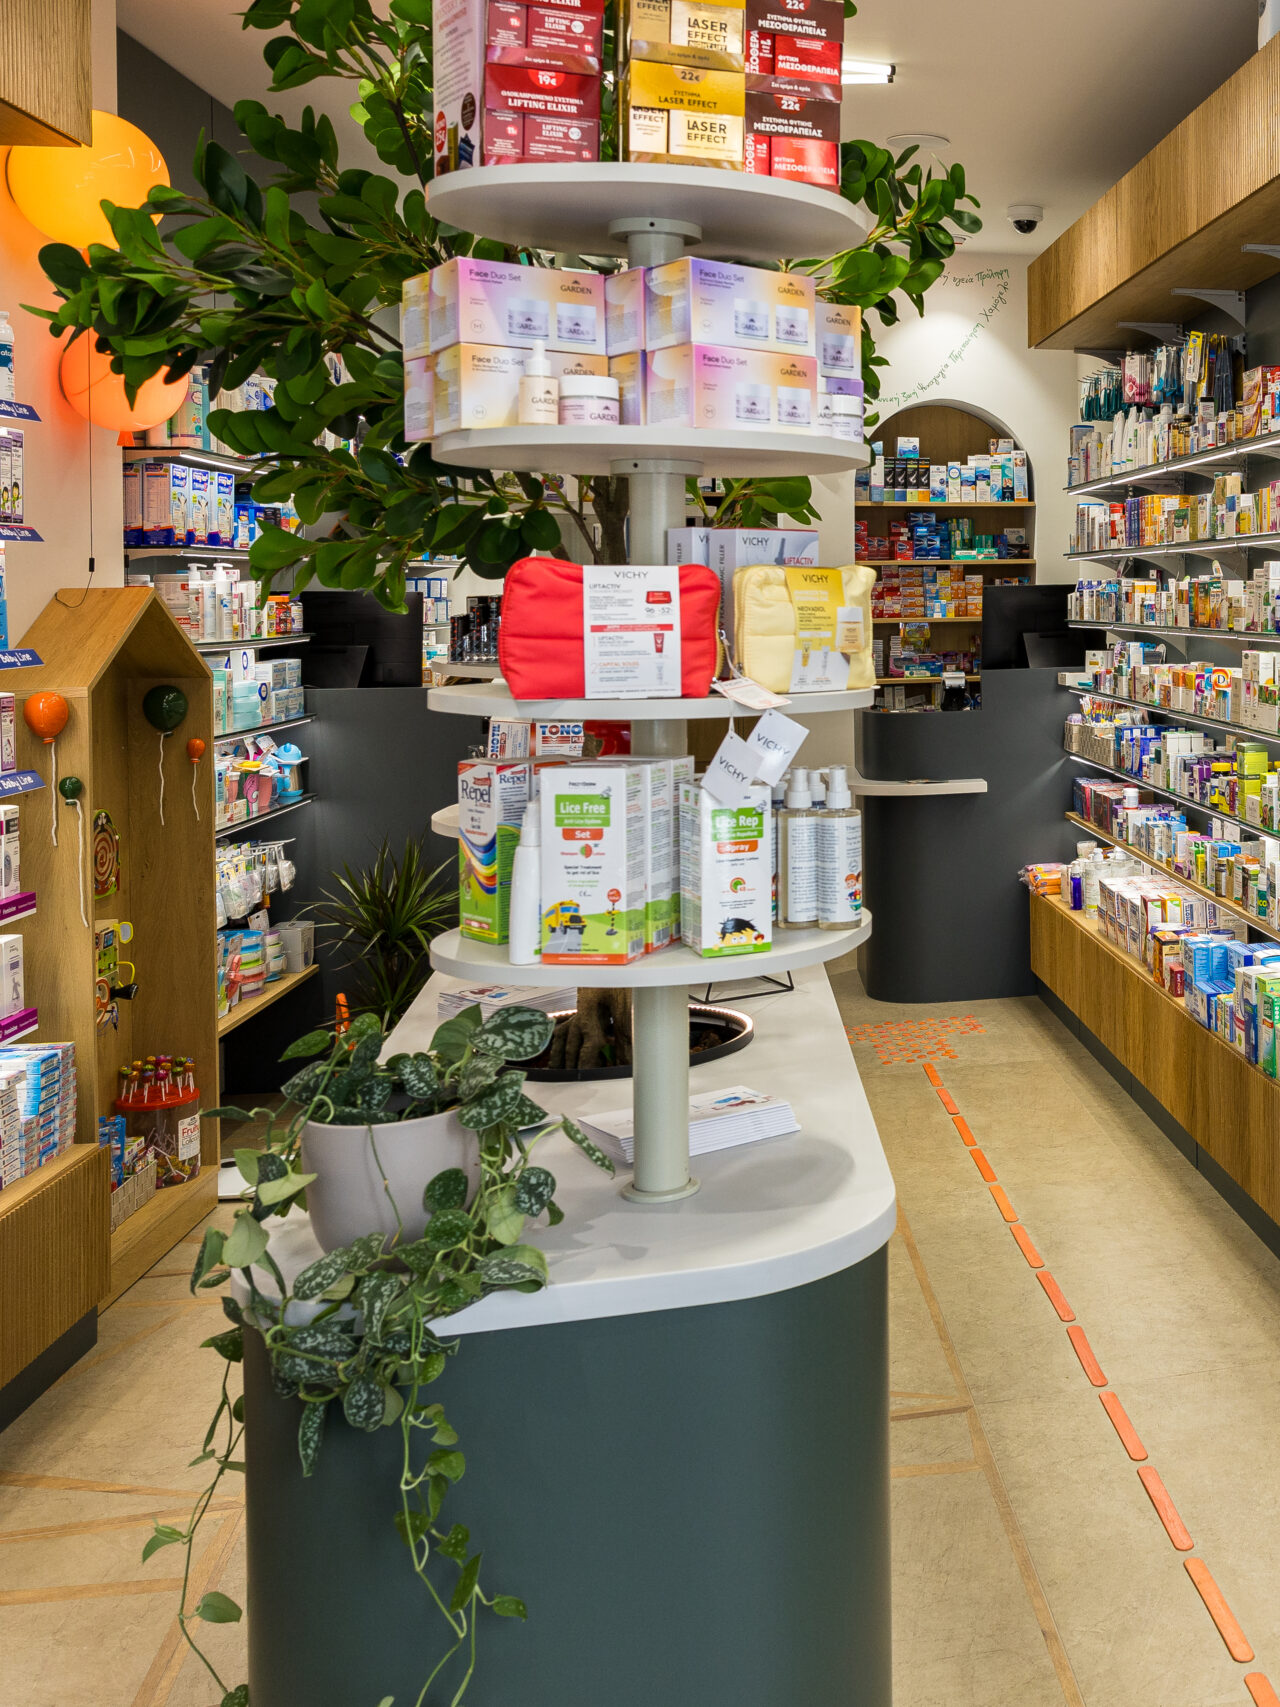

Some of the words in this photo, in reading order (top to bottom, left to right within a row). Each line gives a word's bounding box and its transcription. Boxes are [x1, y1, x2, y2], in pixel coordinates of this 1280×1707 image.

[688, 18, 728, 32] LASER
[758, 20, 827, 37] ΜΕΣΟΘΕΡΑΠΕΙΑΣ
[688, 30, 727, 42] EFFECT
[778, 62, 839, 76] ΜΕΣΟΘΕΡΑΠΕΙΑ
[538, 74, 557, 86] 19€
[681, 71, 700, 81] 22€
[508, 98, 545, 110] LIFTING
[547, 103, 578, 113] ELIXIR
[659, 96, 684, 105] LASER
[688, 99, 717, 109] EFFECT
[781, 100, 800, 111] 22€
[633, 113, 665, 123] EFFECT
[687, 120, 727, 134] LASER
[754, 122, 823, 137] ΜΕΣΟΘΕΡΑΠΕΙΑΣ
[687, 133, 727, 144] EFFECT
[469, 269, 488, 279] Face
[490, 271, 507, 280] Duo
[508, 273, 521, 282] Set
[699, 269, 716, 279] Face
[718, 271, 732, 280] Duo
[734, 274, 744, 282] Set
[560, 285, 592, 295] GARDEN
[778, 286, 805, 297] GARDEN
[826, 317, 851, 326] GARDEN
[472, 355, 491, 363] Face
[493, 357, 510, 365] Duo
[703, 354, 719, 363] Face
[721, 357, 735, 365] Duo
[736, 358, 747, 366] Set
[780, 369, 807, 378] GARDEN
[743, 537, 769, 546] VICHY
[614, 571, 649, 579] VICHY
[802, 574, 829, 583] VICHY
[1, 652, 18, 666] Baby
[757, 733, 790, 756] VICHY
[718, 756, 748, 782] VICHY
[7, 777, 20, 791] Baby
[499, 774, 527, 785] Repel
[461, 779, 493, 806] Repel
[560, 802, 580, 814] Lice
[583, 803, 606, 814] Free
[739, 816, 759, 828] Rep
[575, 830, 591, 839] Set
